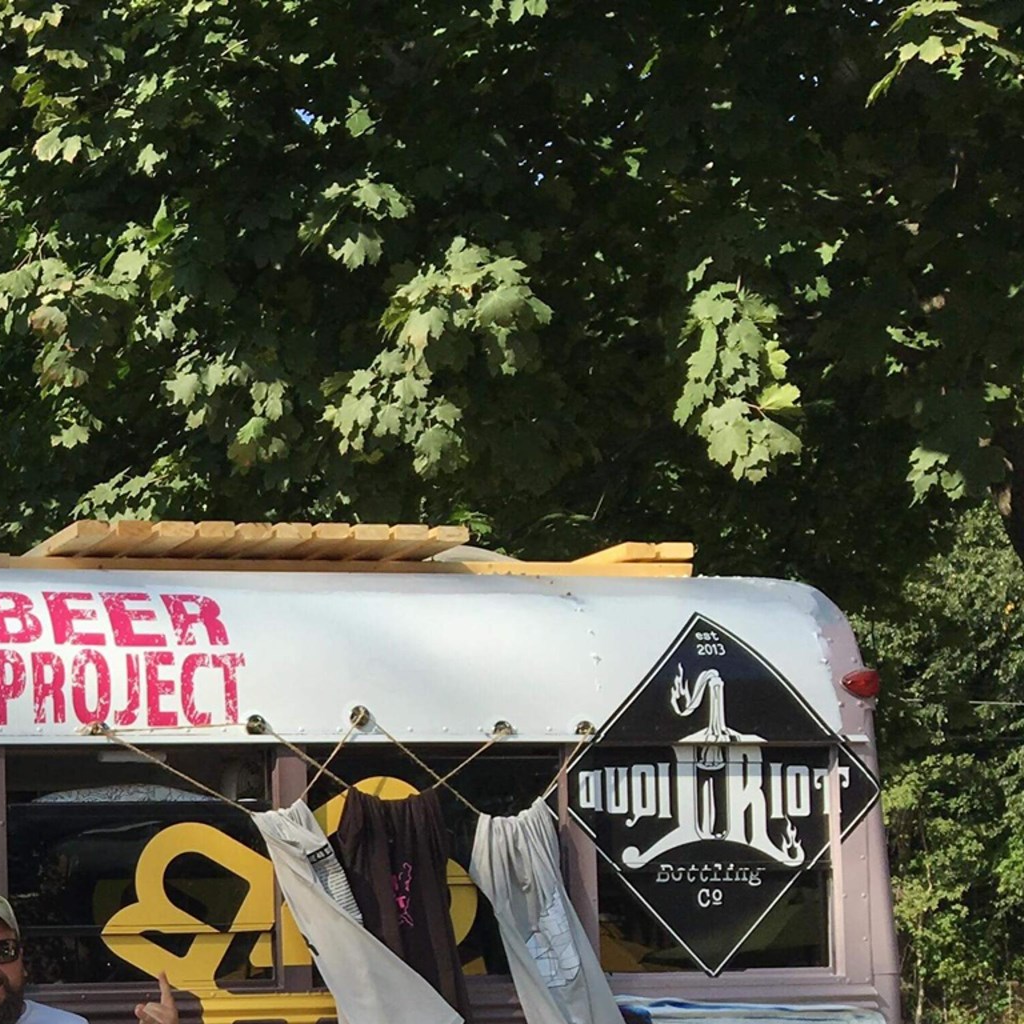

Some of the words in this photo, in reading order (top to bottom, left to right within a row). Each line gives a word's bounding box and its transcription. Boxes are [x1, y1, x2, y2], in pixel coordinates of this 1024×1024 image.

[695, 631, 719, 642] est
[696, 643, 726, 656] 2013
[656, 863, 766, 885] Bottling
